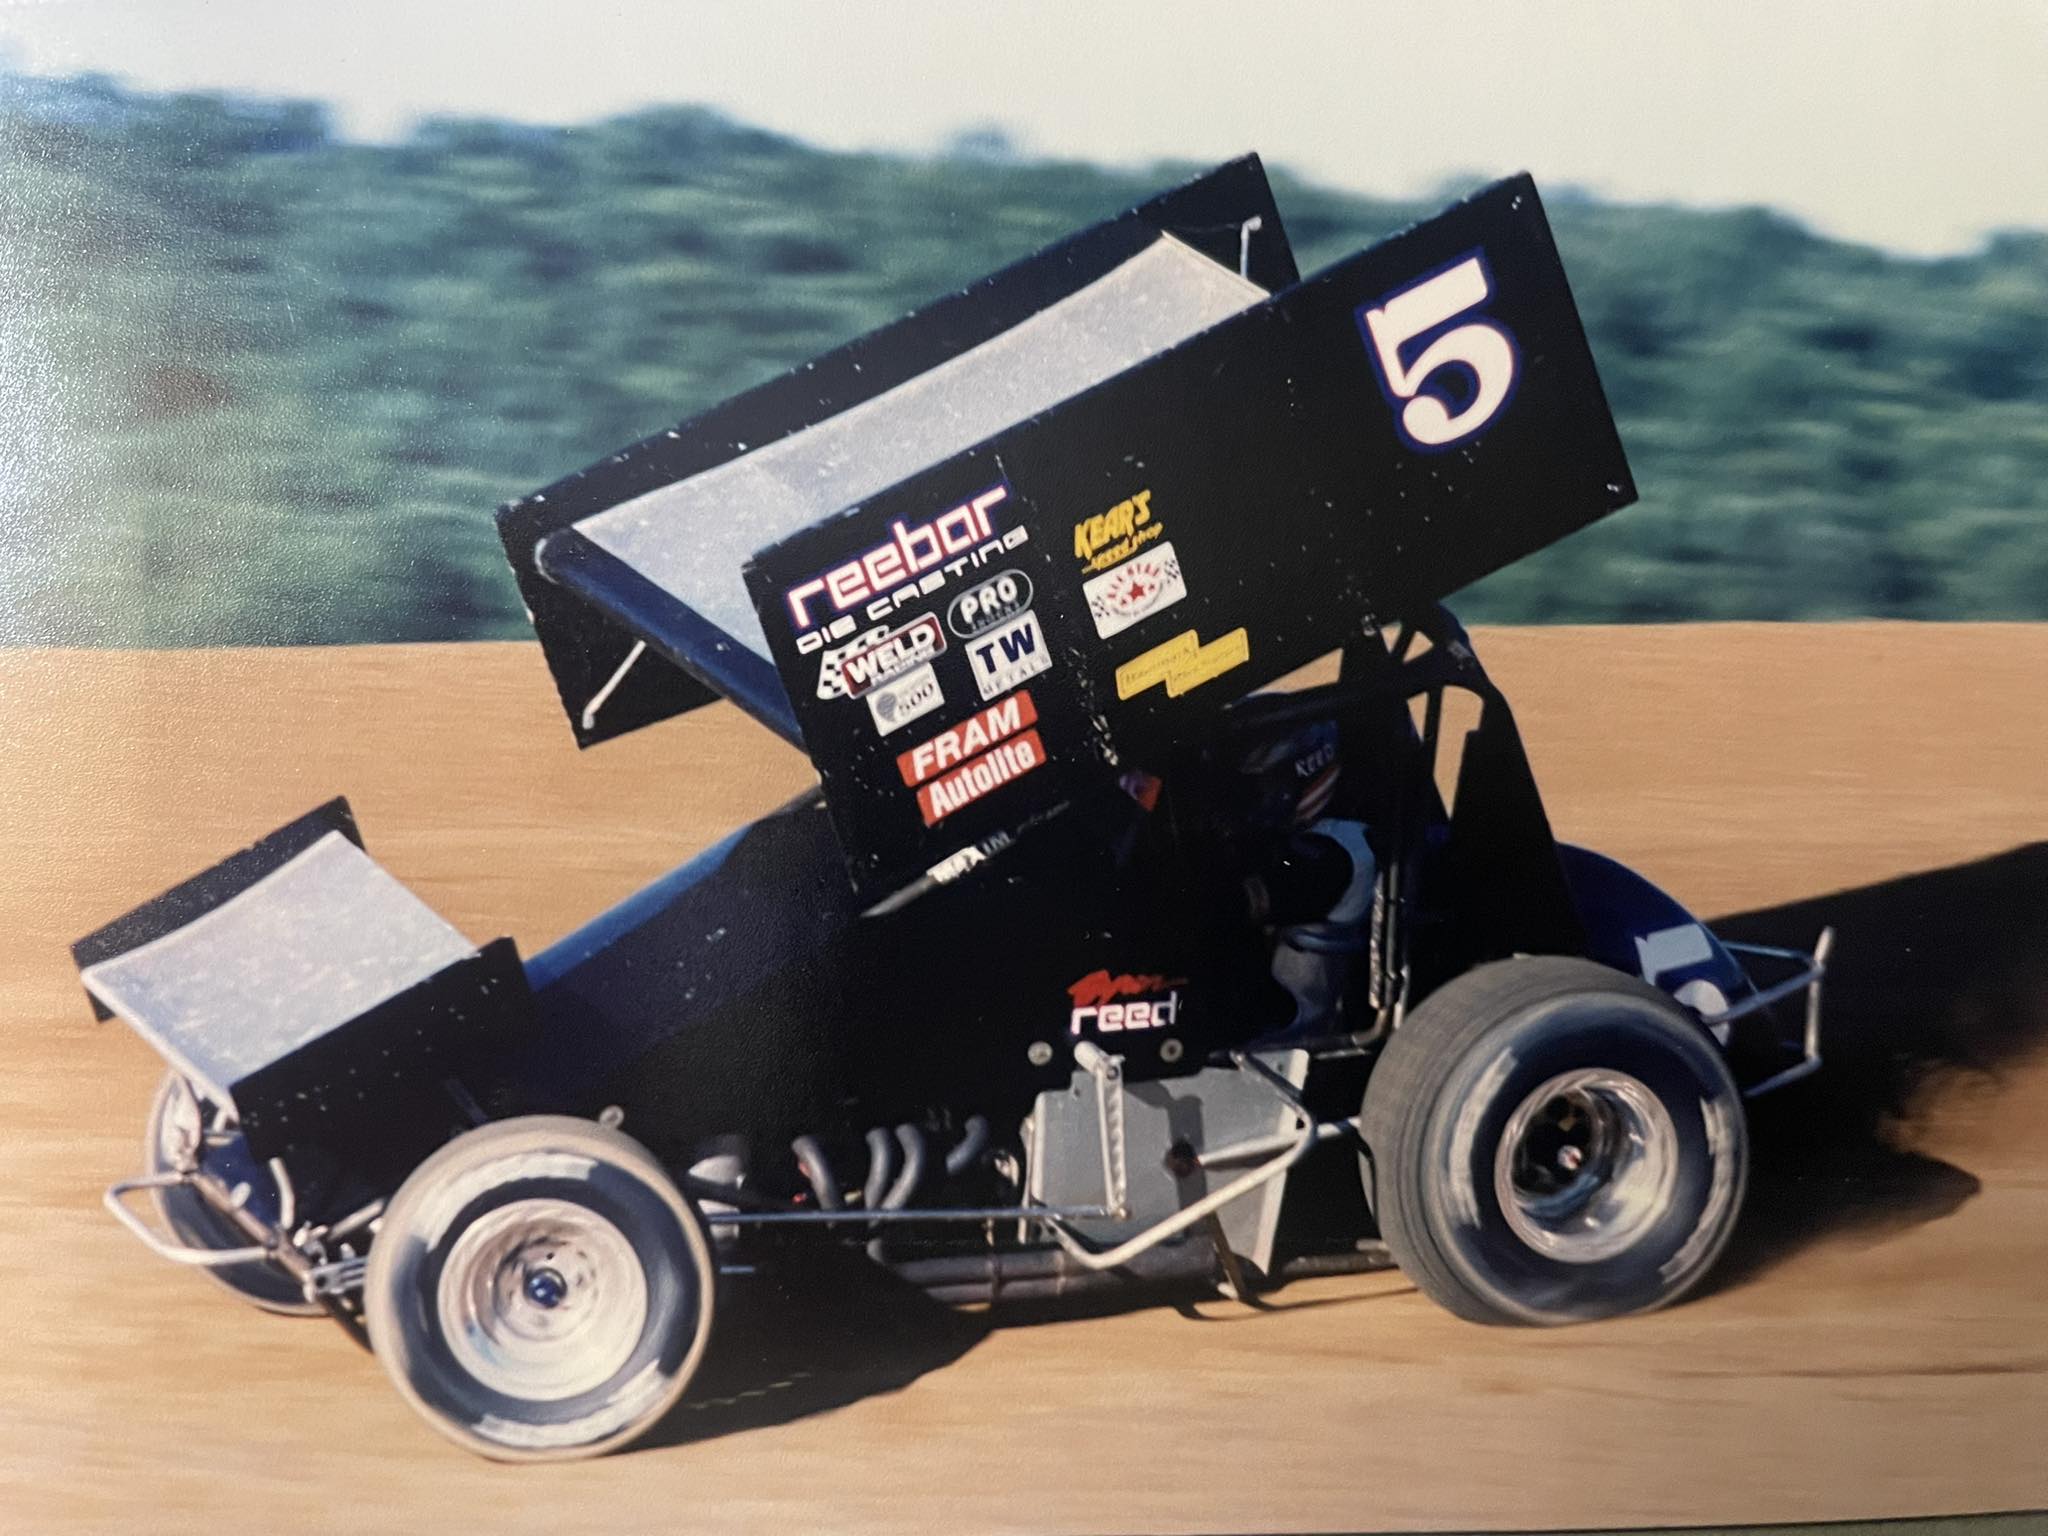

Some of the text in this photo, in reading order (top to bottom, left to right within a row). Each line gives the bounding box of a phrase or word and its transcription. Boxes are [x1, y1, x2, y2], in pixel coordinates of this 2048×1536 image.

[1361, 254, 1516, 448] 5
[787, 484, 1008, 628] reebar
[959, 575, 1019, 626] PRO
[844, 623, 936, 685] WELD
[975, 622, 1037, 676] TW
[911, 696, 1022, 782] FRAM
[928, 740, 1036, 818] Autolite
[1069, 990, 1178, 1036] reed
